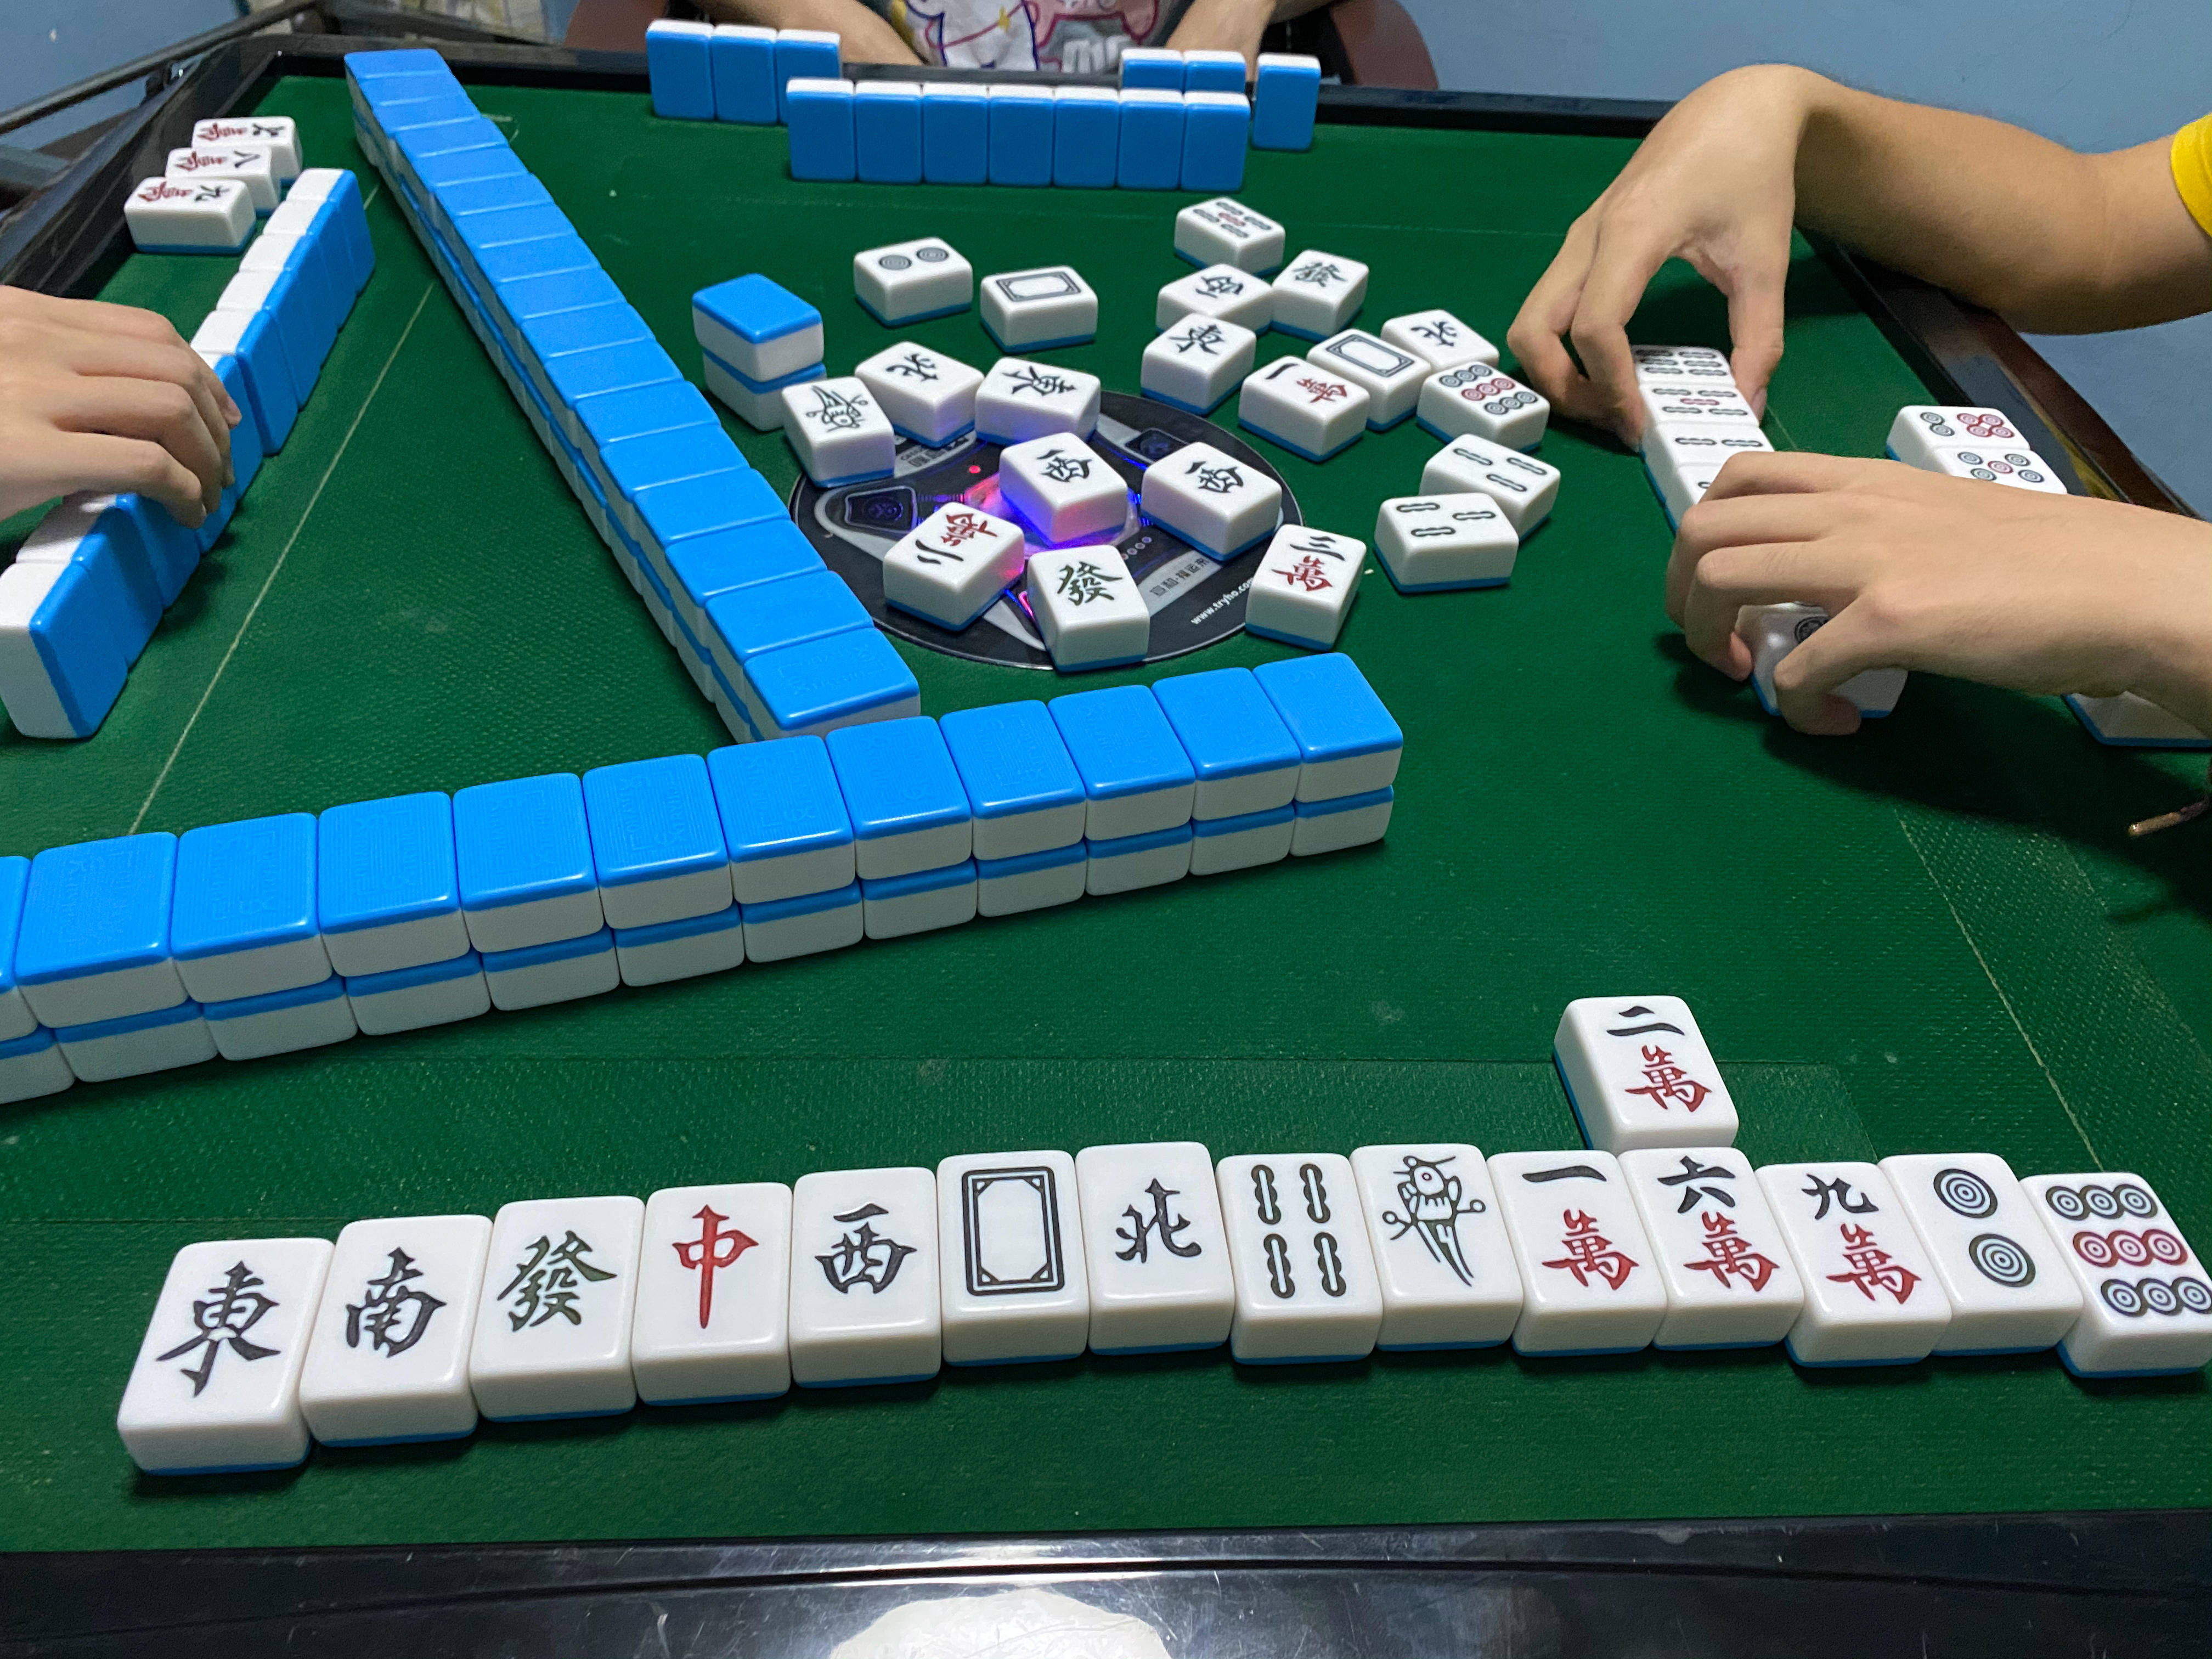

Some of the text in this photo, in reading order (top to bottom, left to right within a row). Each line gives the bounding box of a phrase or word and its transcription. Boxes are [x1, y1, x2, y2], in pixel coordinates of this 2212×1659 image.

[175, 150, 261, 172] 八萬
[137, 181, 230, 202] 九萬
[1195, 275, 1244, 298] 西
[1292, 261, 1348, 288] 發
[1169, 324, 1225, 356] 東
[1410, 320, 1458, 347] 北
[885, 353, 939, 382] 北
[1001, 365, 1076, 396] 東
[1265, 363, 1348, 404] 一萬
[1036, 449, 1093, 483] 西
[1184, 460, 1244, 494] 西
[915, 512, 998, 565] 二萬
[1057, 561, 1124, 607] 發
[1271, 535, 1347, 592] 三萬
[1606, 1005, 1713, 1113] 二萬
[1115, 1177, 1203, 1264] 北
[1522, 1164, 1640, 1291] 一萬
[1657, 1155, 1781, 1293] 六萬
[1801, 1172, 1922, 1305] 九萬
[672, 1204, 759, 1329] 中
[815, 1203, 918, 1295] 西
[345, 1246, 447, 1358] 南
[496, 1230, 618, 1333] 發
[156, 1260, 281, 1398] 東
